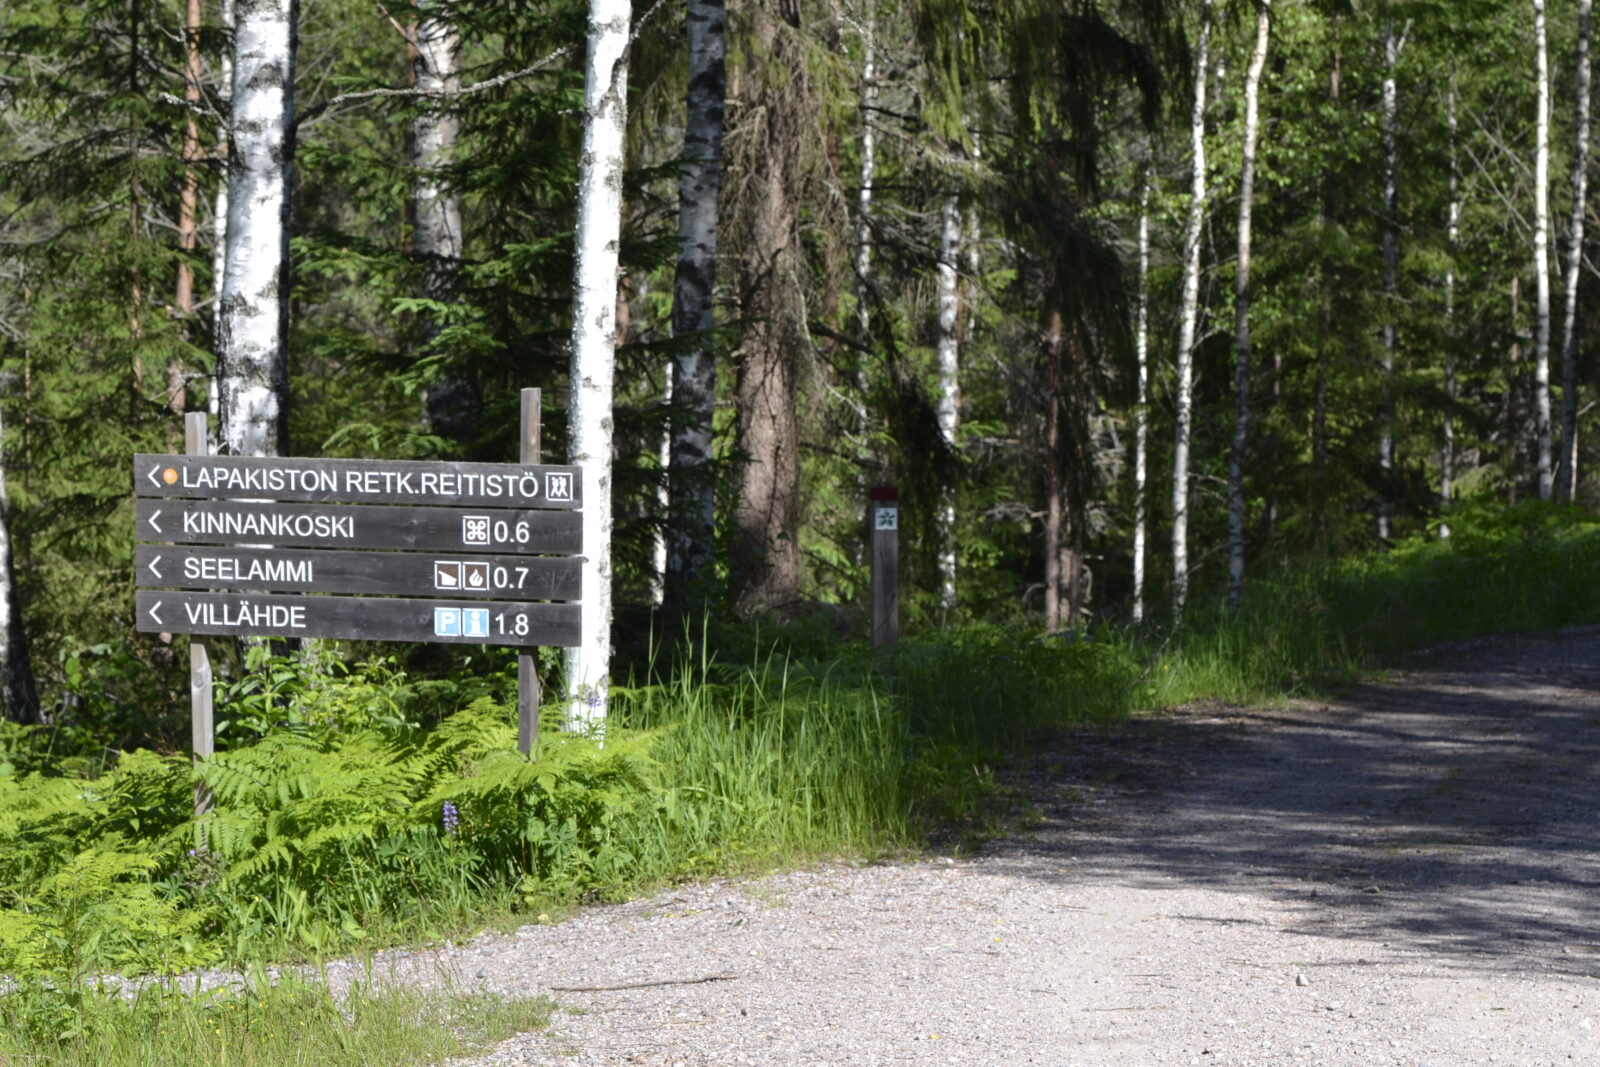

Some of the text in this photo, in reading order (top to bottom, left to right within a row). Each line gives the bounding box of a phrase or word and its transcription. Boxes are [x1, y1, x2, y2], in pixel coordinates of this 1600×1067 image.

[182, 465, 538, 497] LAPAKISTON RETK.REITISTÖ
[184, 511, 529, 543] KINNANKOSKI 0.6
[184, 557, 529, 589] SEELAMMI 0.7
[185, 601, 306, 628] VILLÄHDE
[495, 614, 529, 636] 1.8
